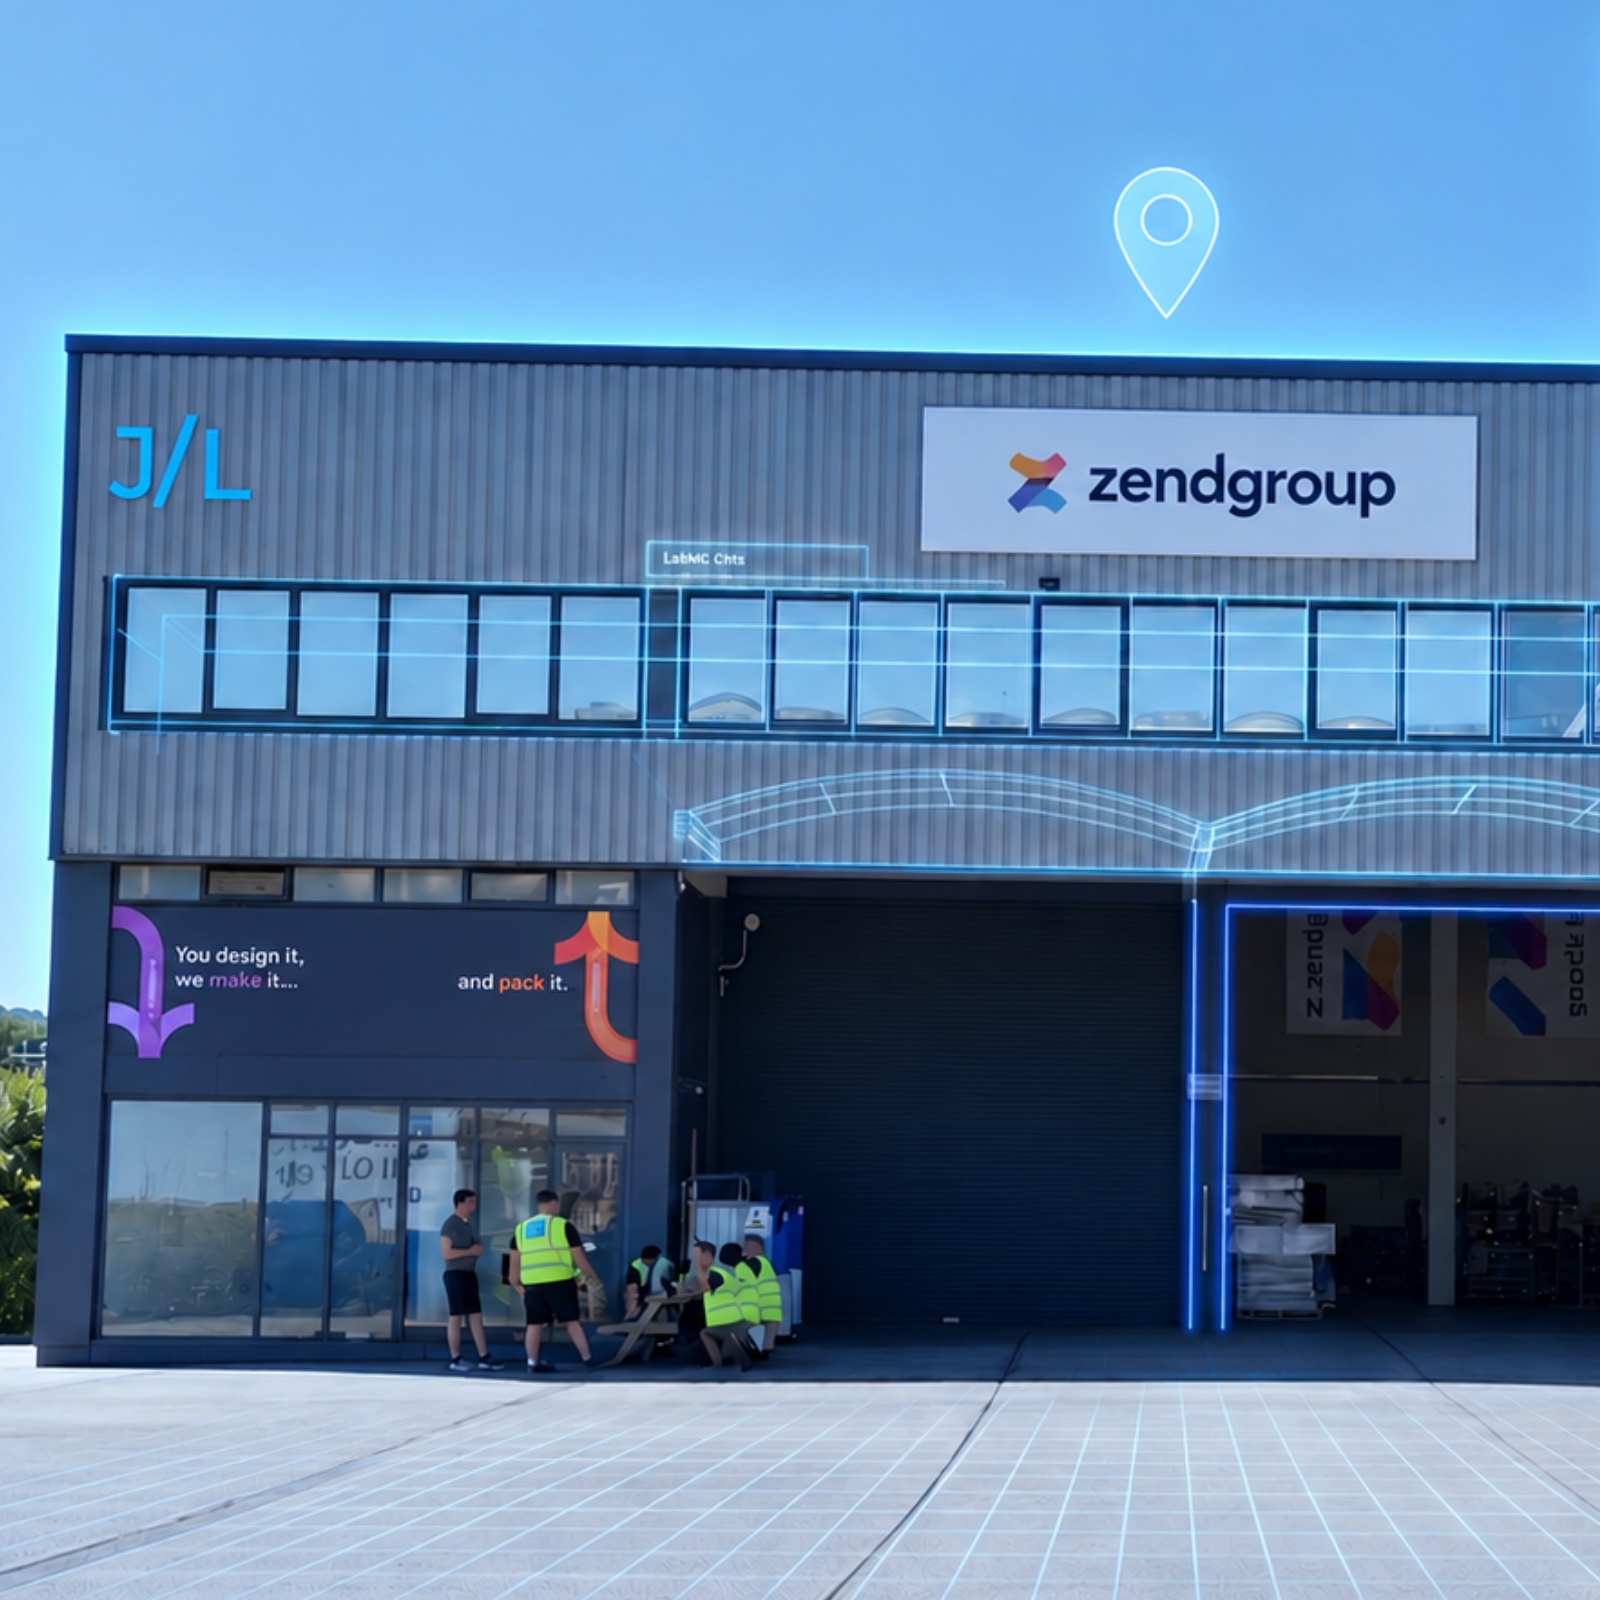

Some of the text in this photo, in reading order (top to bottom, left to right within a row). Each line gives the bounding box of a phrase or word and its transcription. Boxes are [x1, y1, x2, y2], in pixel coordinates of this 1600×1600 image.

[1088, 452, 1396, 518] zendgroup
[175, 946, 305, 968] You design it,
[175, 973, 204, 988] we
[209, 971, 262, 988] make
[457, 973, 569, 994] and pack it.
